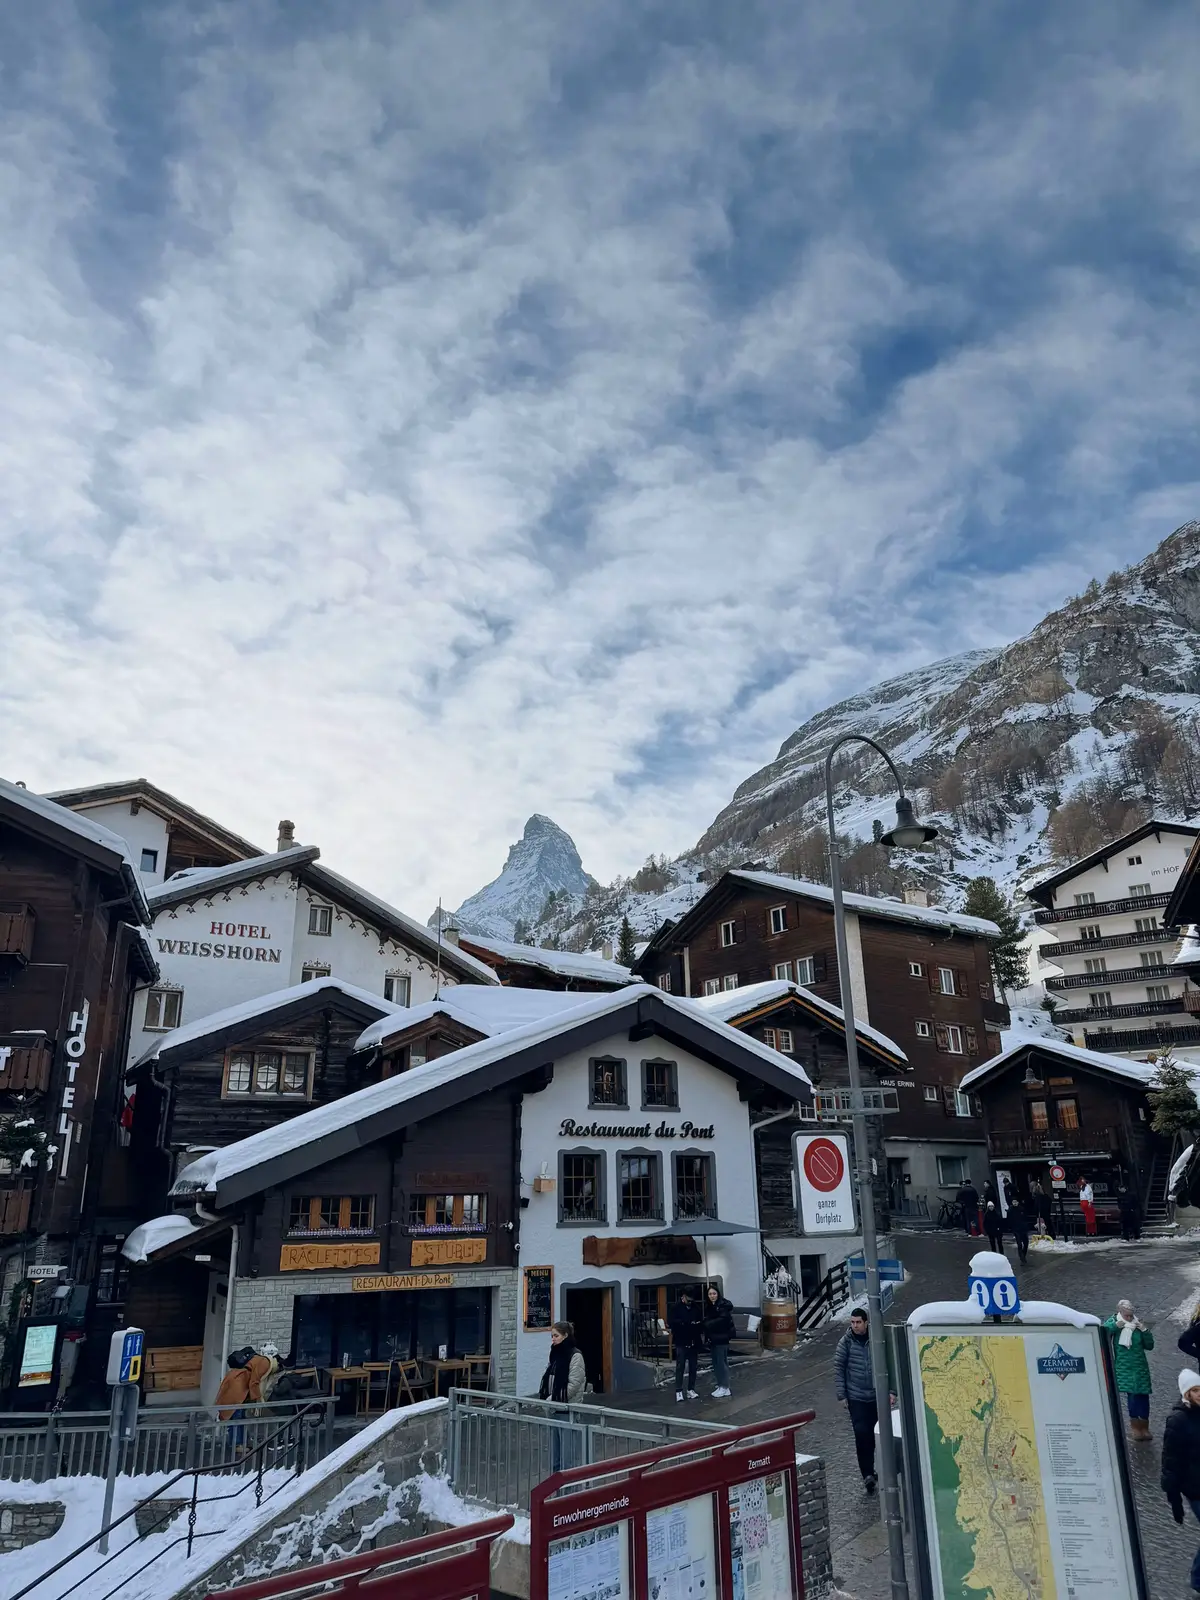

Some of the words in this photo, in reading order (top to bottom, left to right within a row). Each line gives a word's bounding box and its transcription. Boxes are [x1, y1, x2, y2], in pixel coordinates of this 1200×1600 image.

[1163, 865, 1180, 874] HOF
[209, 921, 271, 940] HOTEL
[156, 938, 282, 963] WEISSHORN
[58, 998, 90, 1177] HOTEL
[880, 1079, 896, 1087] HAUS
[897, 1080, 915, 1088] ERWIN
[558, 1118, 651, 1138] Restaurant
[654, 1120, 677, 1138] du
[679, 1120, 715, 1139] Pont
[817, 1199, 837, 1210] ganzer
[815, 1212, 842, 1225] Dorfplatz
[288, 1247, 373, 1265] RACLETTES
[30, 1267, 56, 1275] HOTEL
[434, 1274, 451, 1285] Pont
[1042, 1359, 1079, 1367] ZERMATT
[553, 1496, 630, 1527] Einwohnergemeinde
[748, 1456, 771, 1470] Zermatt
